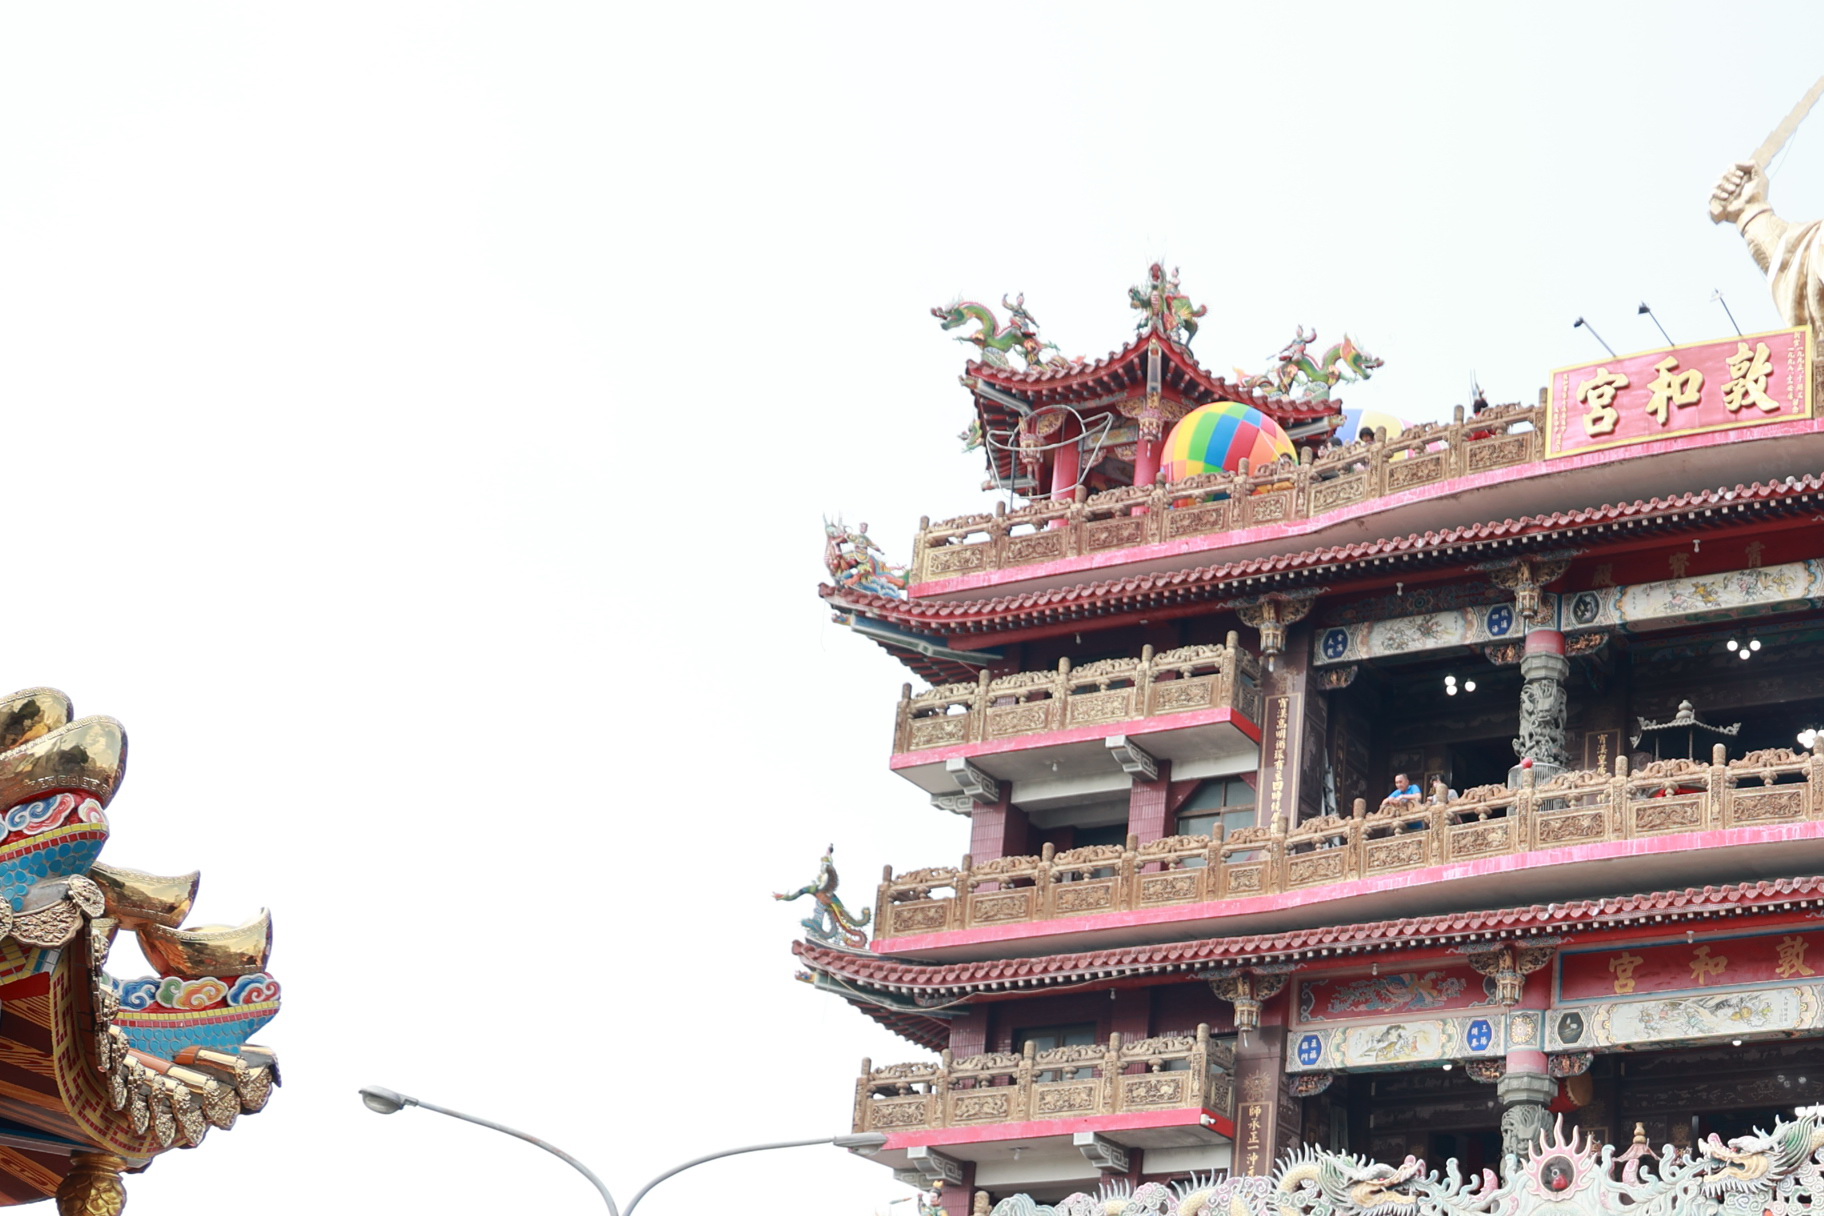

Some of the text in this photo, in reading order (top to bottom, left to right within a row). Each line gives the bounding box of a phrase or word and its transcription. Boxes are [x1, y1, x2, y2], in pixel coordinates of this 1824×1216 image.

[1576, 341, 1780, 437] 敦和宮
[1607, 935, 1816, 995] 敦和宮
